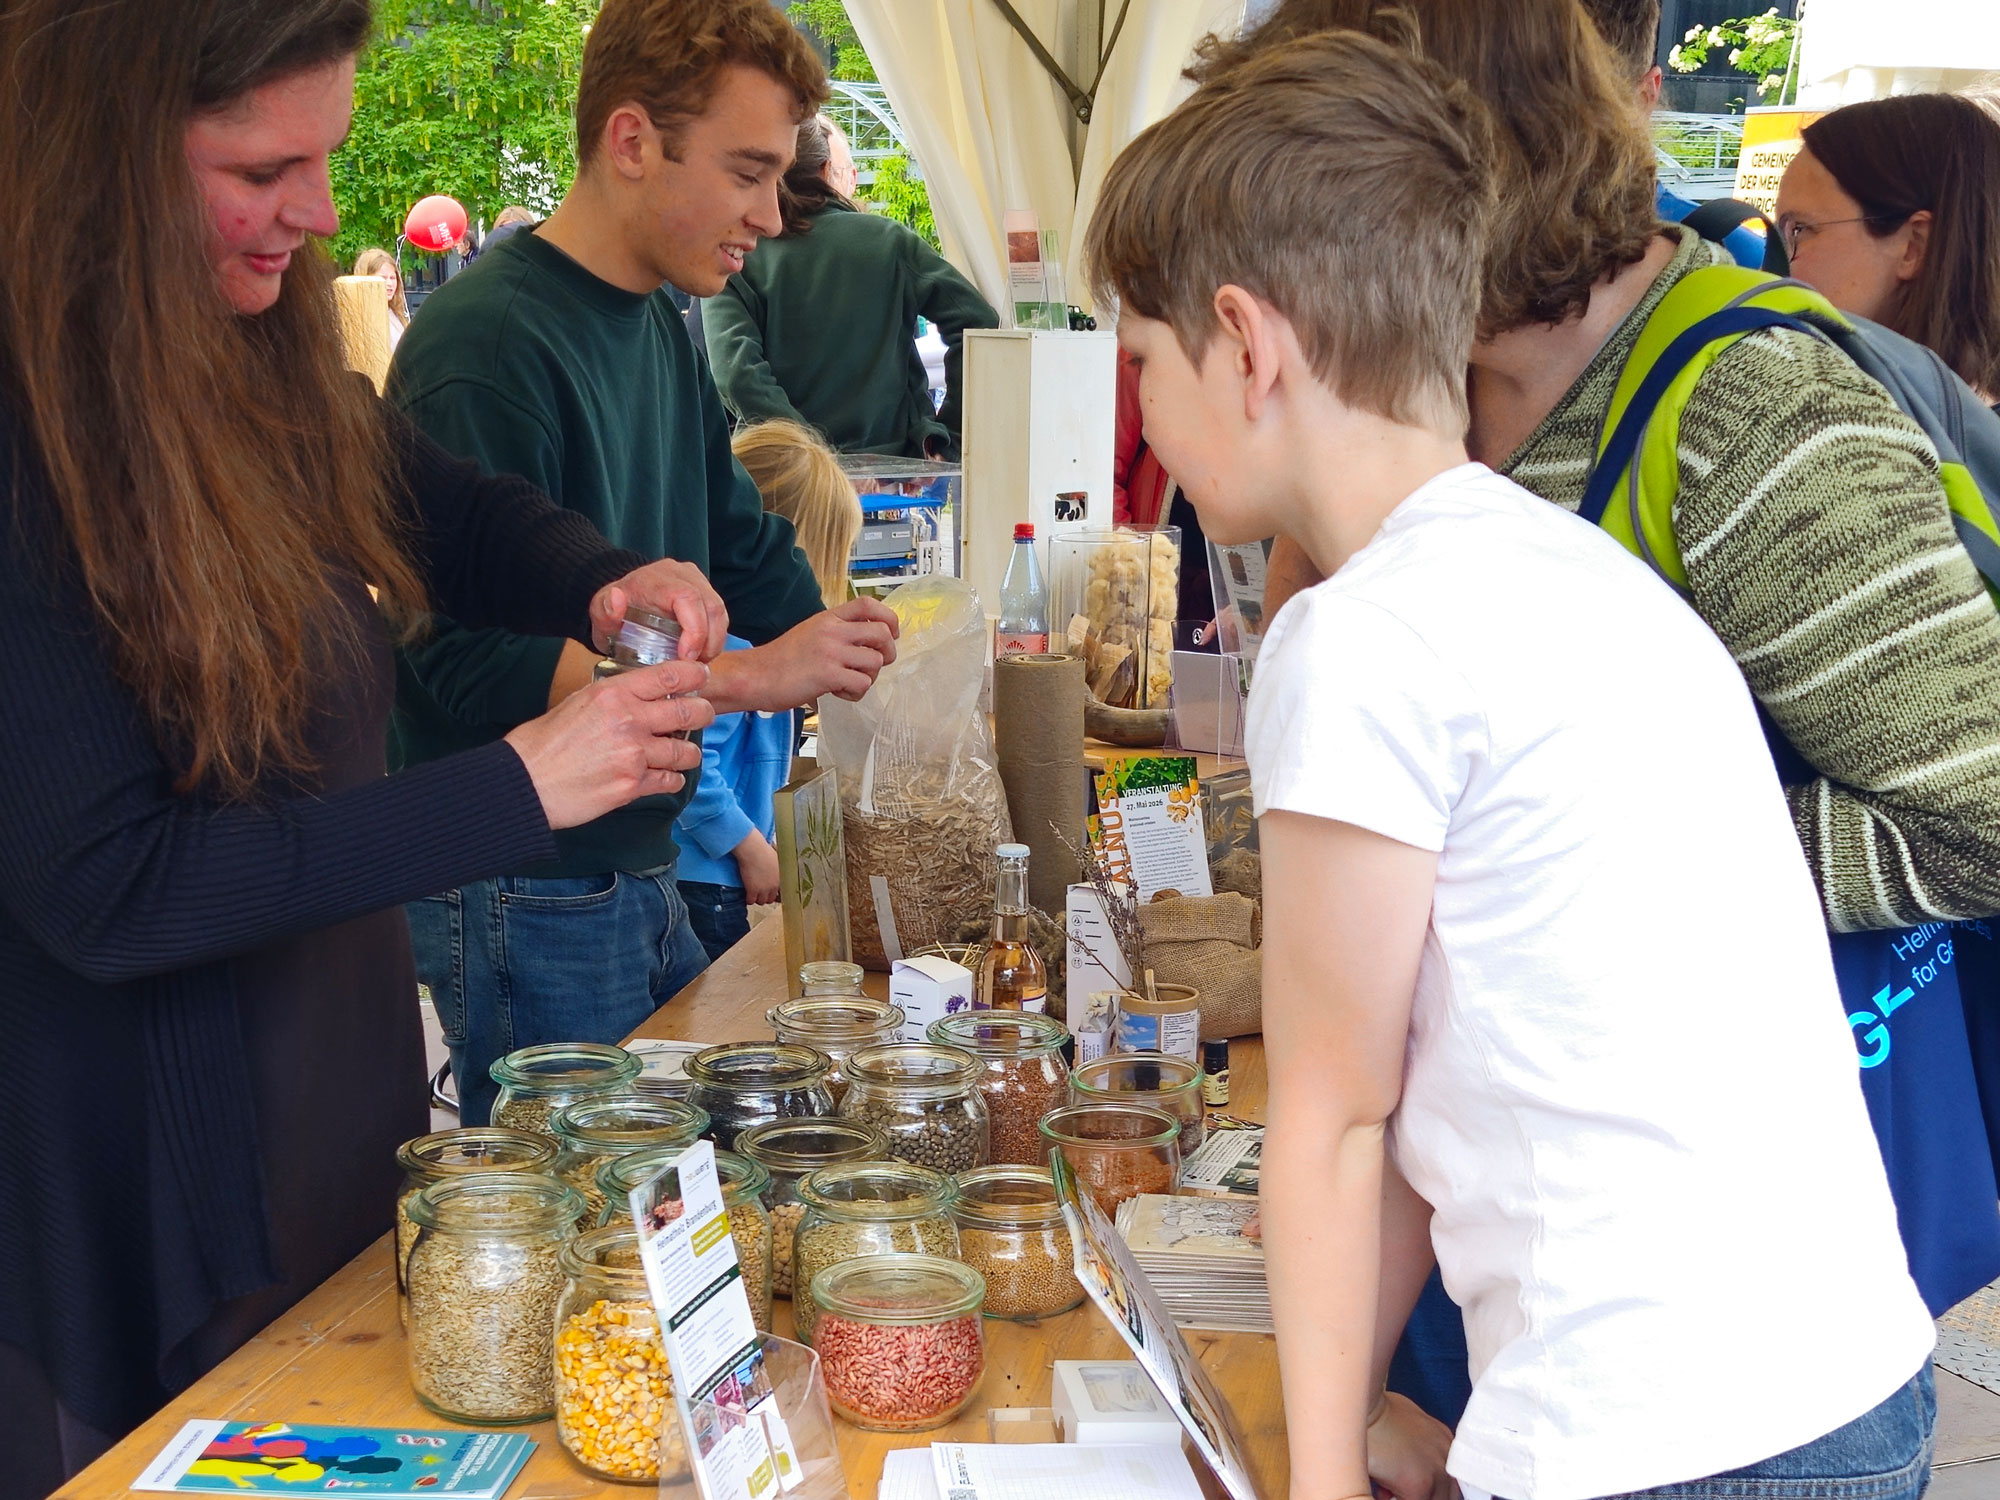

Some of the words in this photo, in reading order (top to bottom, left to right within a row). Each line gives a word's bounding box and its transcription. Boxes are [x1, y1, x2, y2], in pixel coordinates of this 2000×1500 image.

[1740, 175, 1757, 190] DER
[1758, 175, 1781, 191] MEH
[1122, 783, 1183, 798] VERANSTALTUNG
[1136, 800, 1148, 809] Mai
[1148, 799, 1164, 809] 2026
[1095, 772, 1132, 885] ALNUSS
[1912, 957, 1938, 988] for
[1937, 939, 1955, 965] Ge
